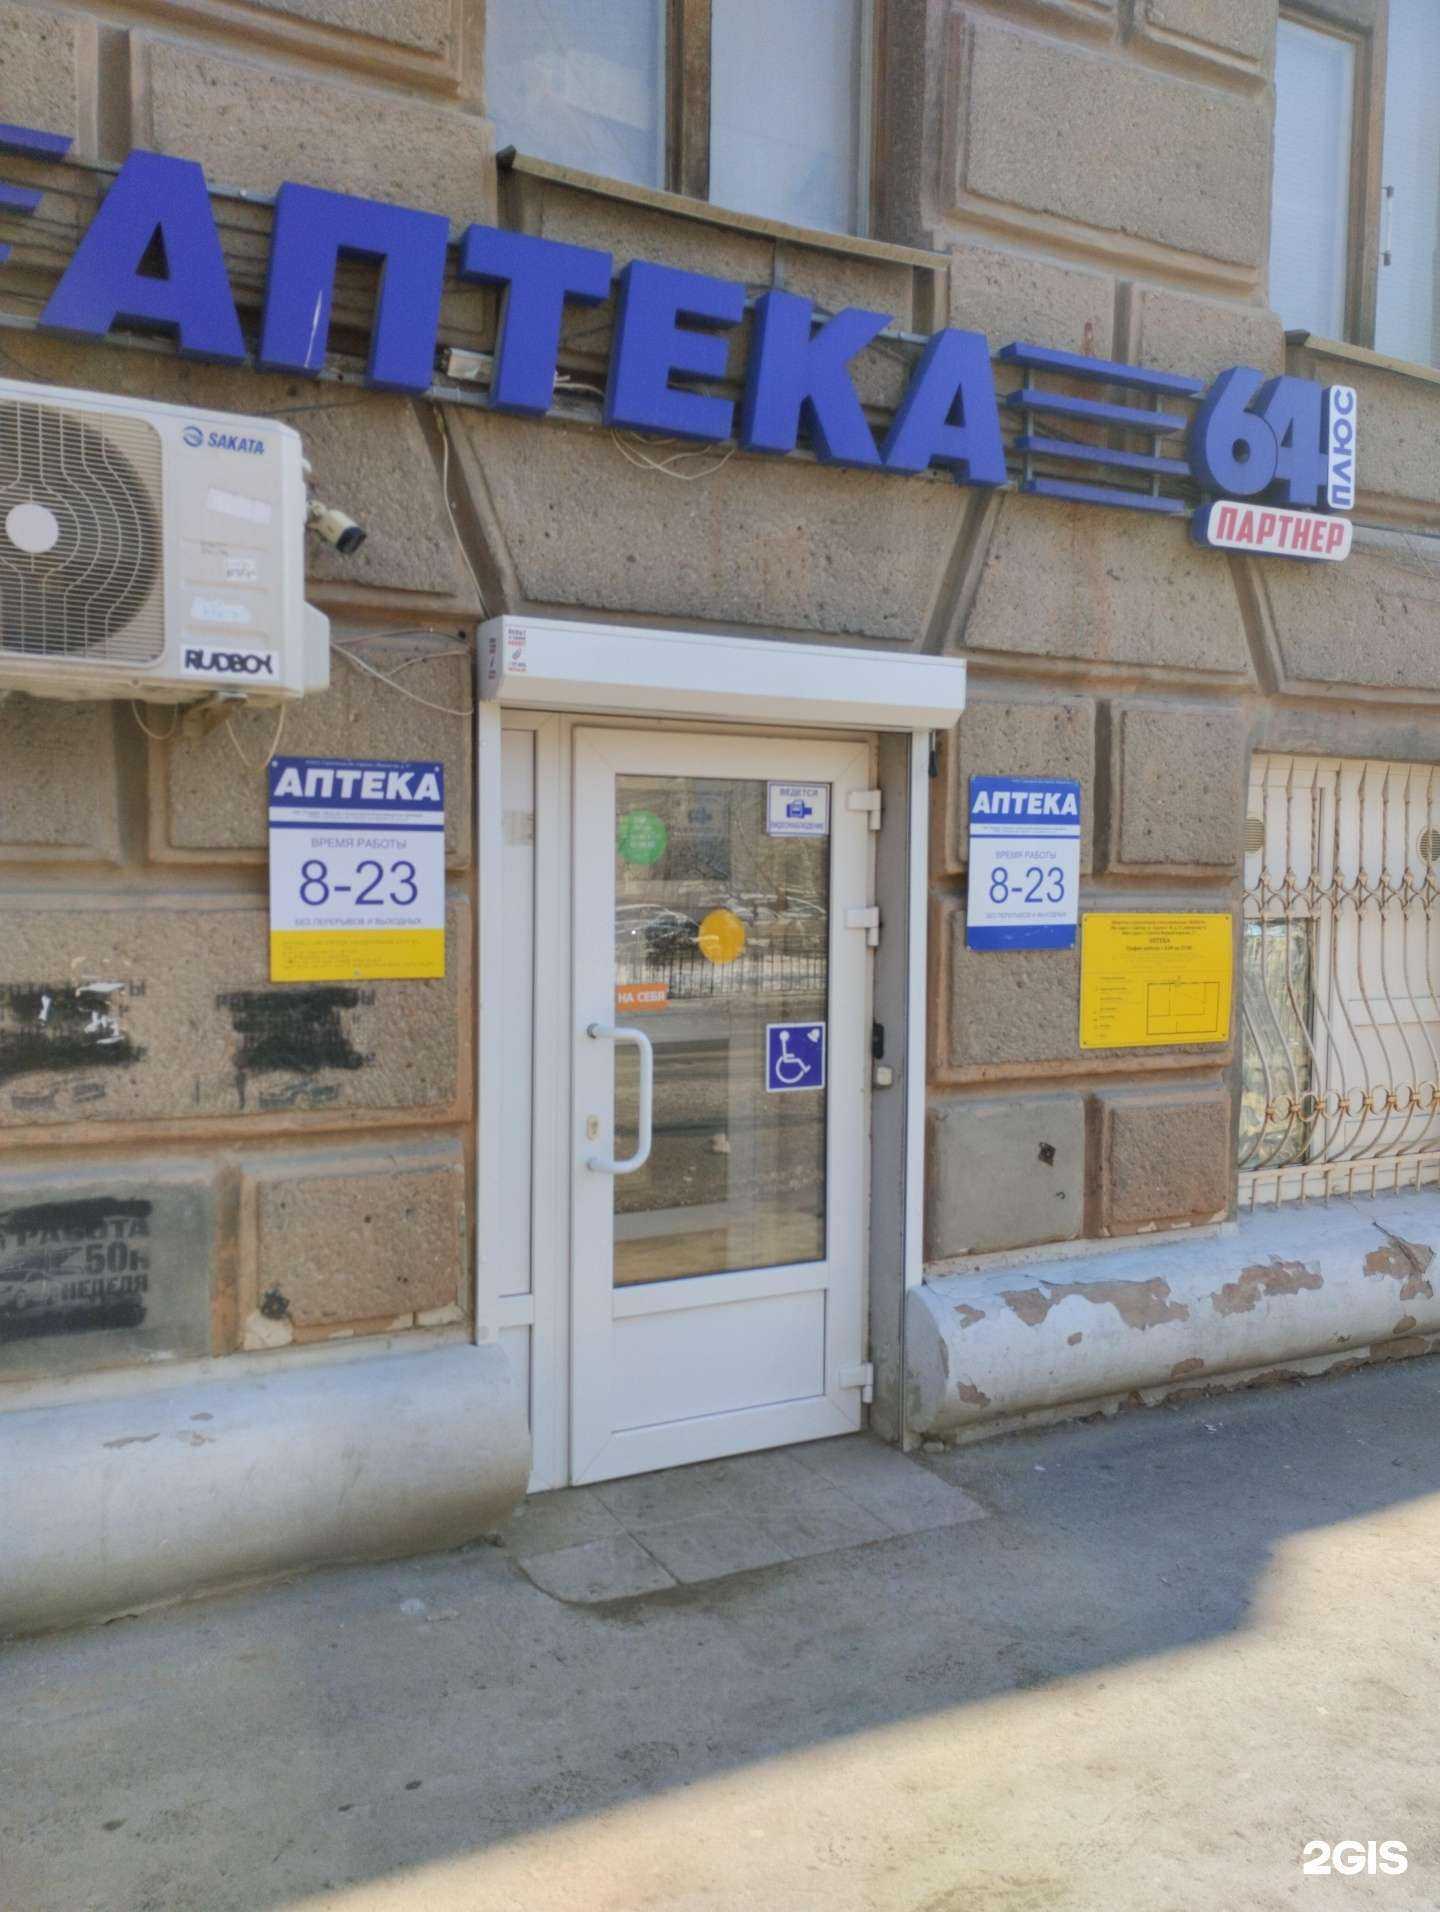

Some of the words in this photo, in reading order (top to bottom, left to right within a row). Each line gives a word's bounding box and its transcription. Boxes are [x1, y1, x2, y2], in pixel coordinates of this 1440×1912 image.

[38, 148, 1008, 488] АПТЕКА
[207, 432, 265, 456] SAKATA
[1203, 366, 1328, 506] 64
[1331, 388, 1354, 507] ПЛЮС
[1215, 506, 1345, 554] ПАРТНЕР
[273, 767, 441, 802] АПТЕКА
[972, 790, 1078, 816] АПТЕКА
[311, 838, 354, 848] ВРЕМЯ
[357, 838, 407, 849] РАБОТЫ
[300, 859, 418, 906] 8-23
[989, 866, 1065, 904] 8-23
